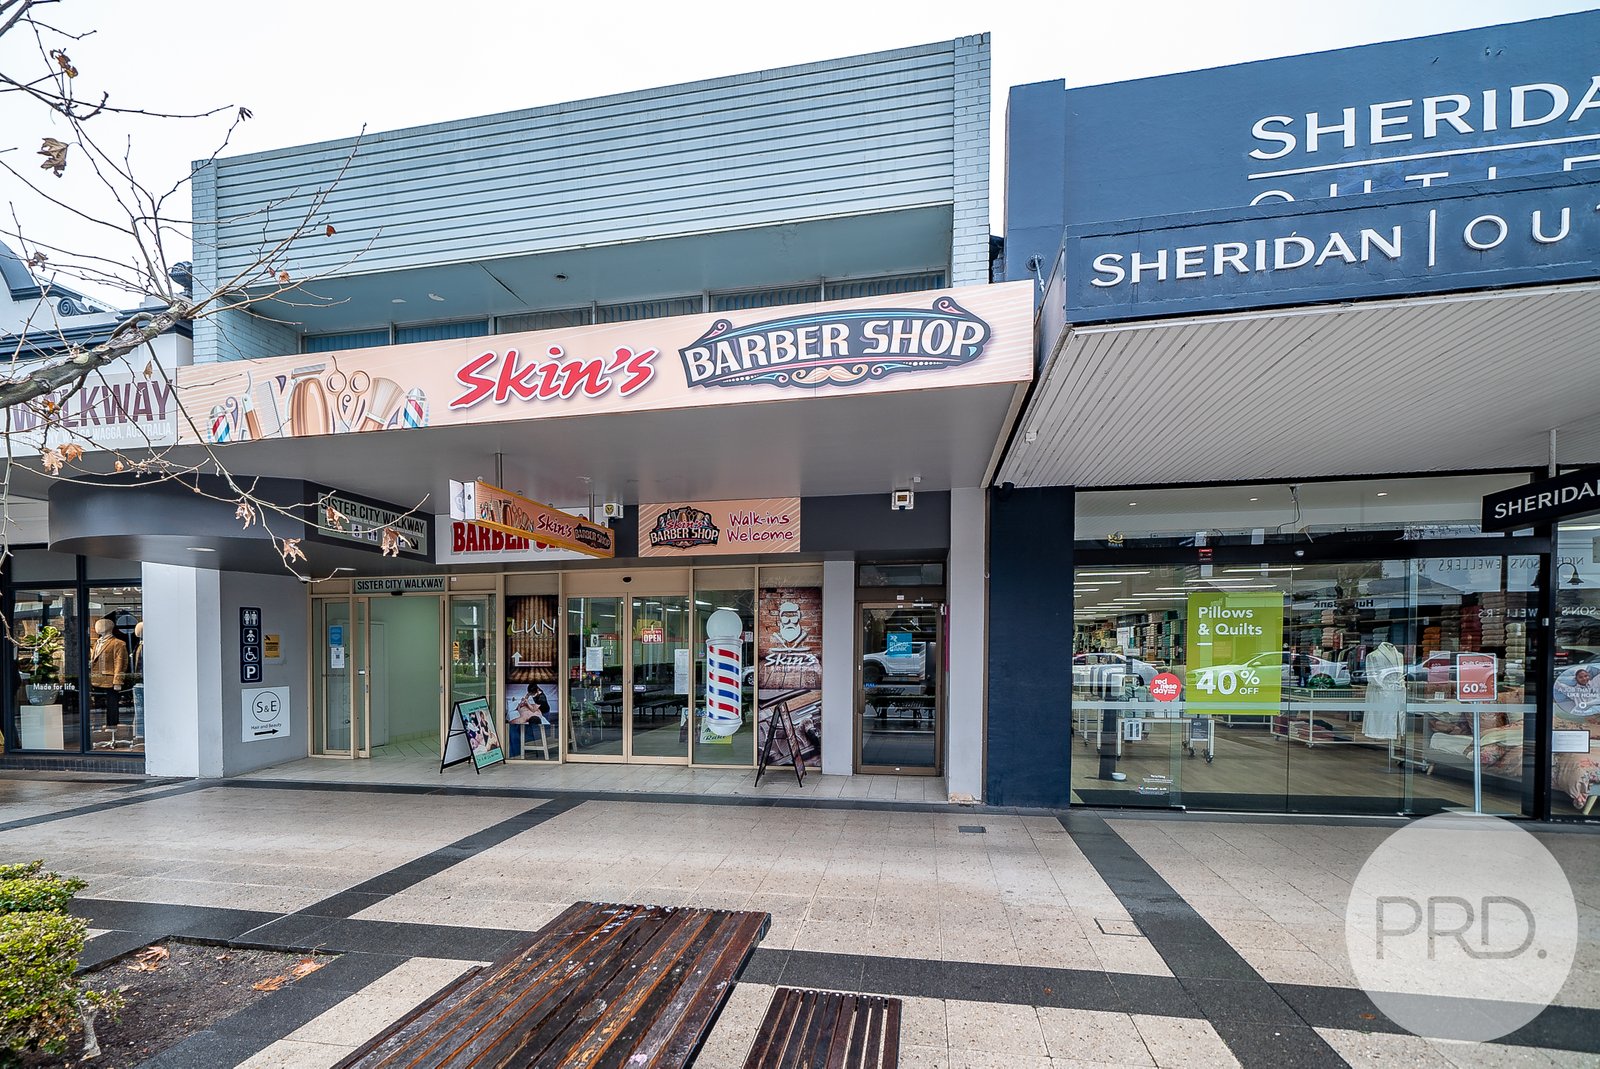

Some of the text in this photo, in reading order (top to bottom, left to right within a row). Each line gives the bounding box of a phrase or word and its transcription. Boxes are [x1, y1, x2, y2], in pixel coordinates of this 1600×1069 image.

[1090, 203, 1600, 288] SHERIDAN OU
[449, 318, 985, 408] Skin's BARBER SHOP
[12, 379, 174, 433] WALKWAY
[1494, 479, 1600, 519] SHERIDA
[320, 495, 357, 518] SISTER
[359, 504, 381, 525] CITY
[382, 511, 425, 534] WALKWAY
[729, 510, 790, 527] Walk-ins
[537, 513, 573, 539] Skin's
[574, 528, 597, 543] BARBER
[650, 527, 719, 544] BARBER SHOP
[726, 527, 794, 543] Welcome
[357, 578, 444, 590] SISTER CITY WALKWAY
[1198, 605, 1254, 619] Pillows
[1197, 622, 1263, 636] & Quilts
[643, 634, 662, 643] OPEN
[246, 666, 256, 679] P
[33, 682, 76, 691] Made for life
[1153, 687, 1167, 696] day
[1239, 687, 1260, 695] OFF
